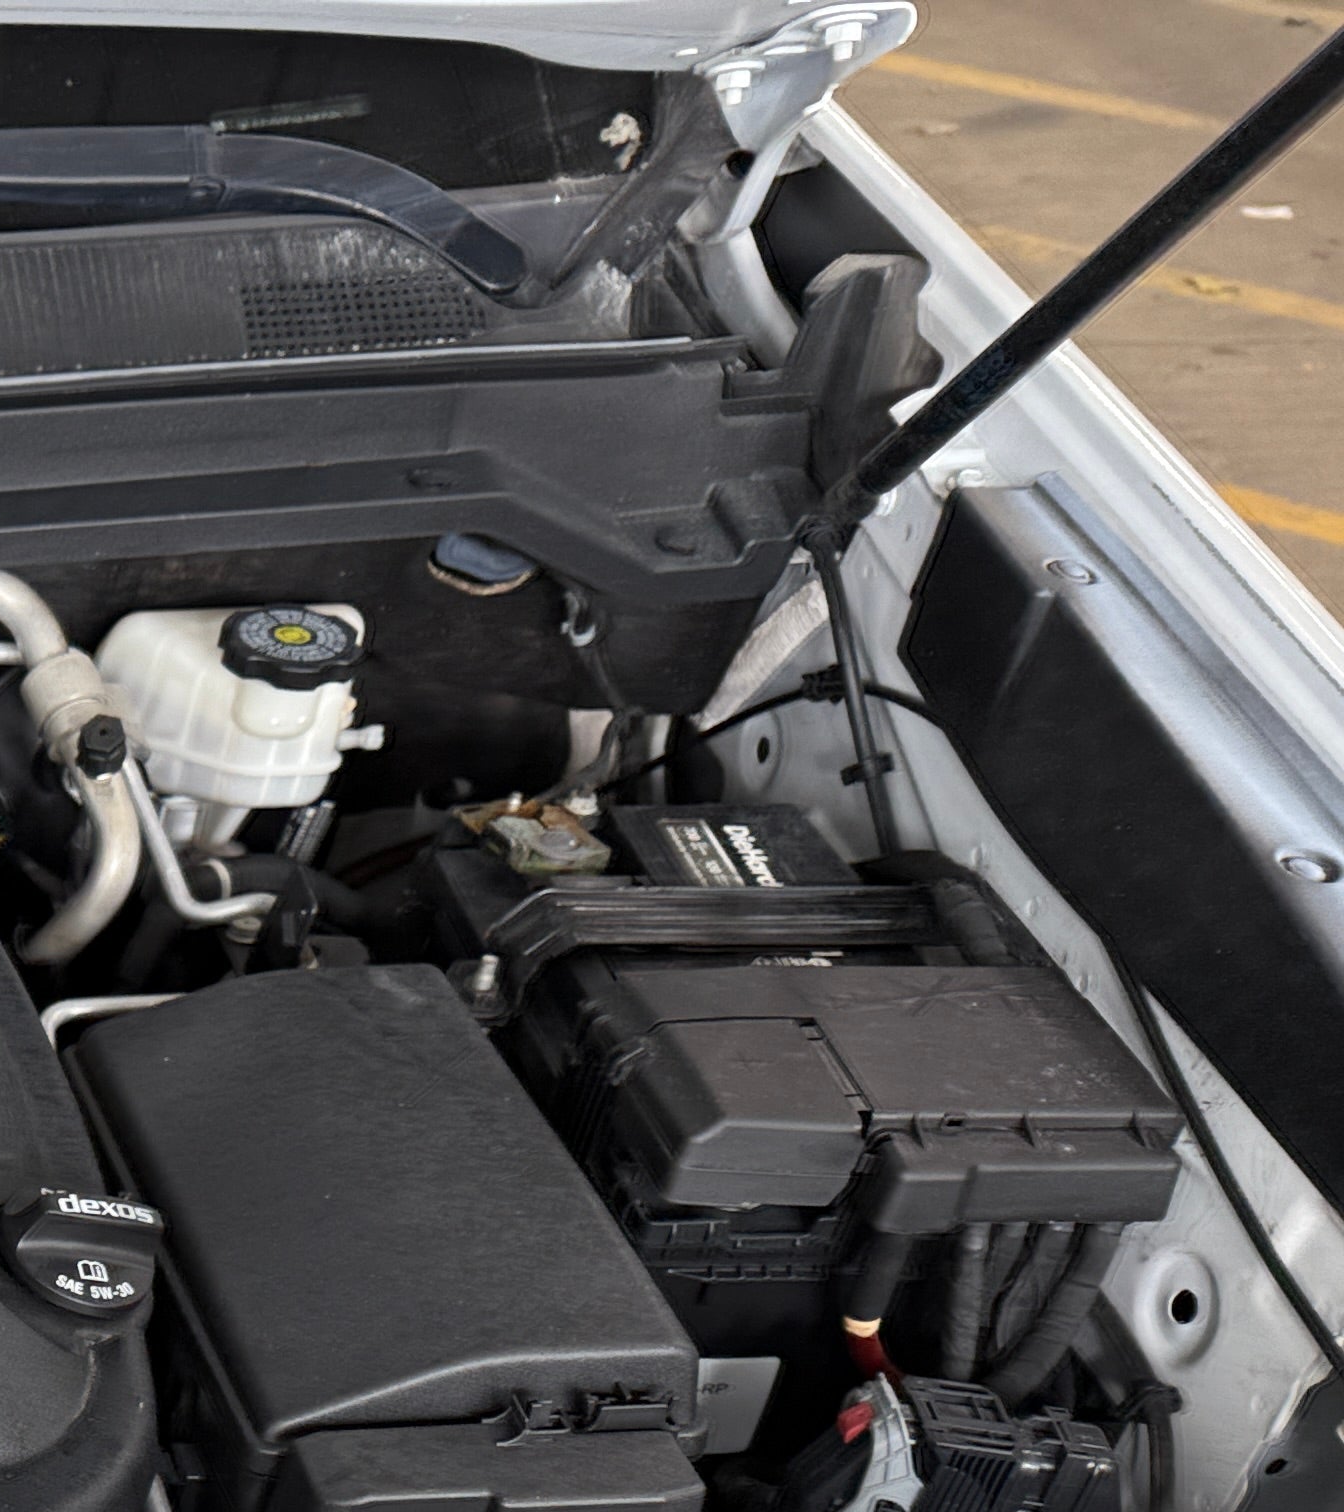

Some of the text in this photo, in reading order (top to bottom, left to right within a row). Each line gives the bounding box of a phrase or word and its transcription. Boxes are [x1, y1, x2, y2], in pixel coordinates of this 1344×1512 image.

[58, 1193, 154, 1225] dexos
[55, 1274, 135, 1300] SAE 5W-30
